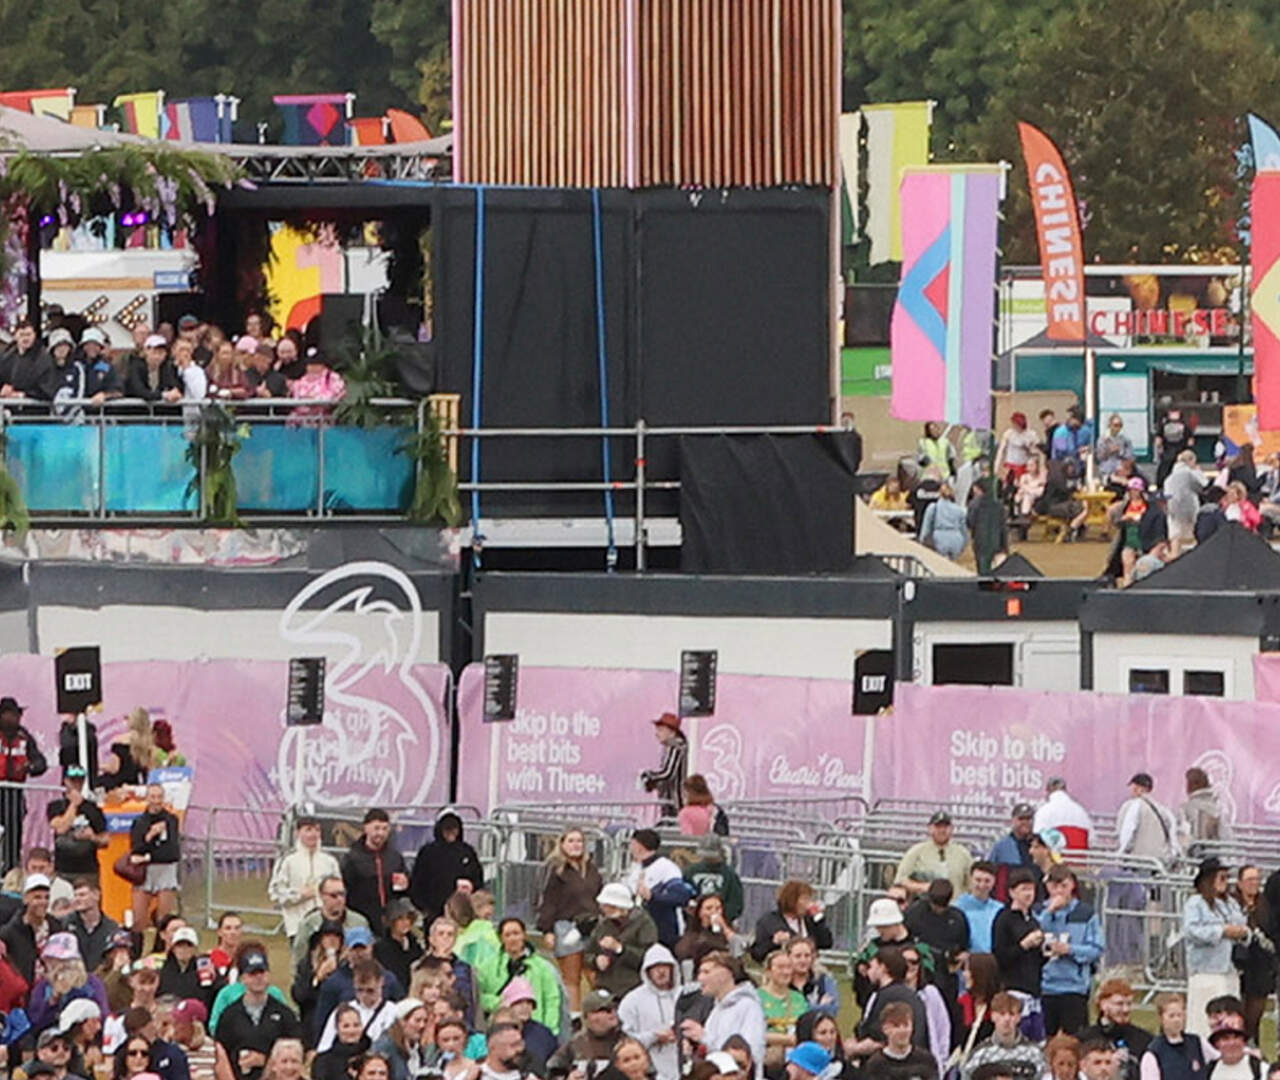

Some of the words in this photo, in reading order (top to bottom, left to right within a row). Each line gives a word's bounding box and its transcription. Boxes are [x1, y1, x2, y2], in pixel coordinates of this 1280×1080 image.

[1091, 309, 1229, 337] CHINESE
[65, 673, 92, 691] EXIT
[862, 674, 887, 693] EXIT
[509, 709, 547, 738] Skip
[550, 712, 570, 735] to
[573, 711, 600, 737] the
[507, 738, 545, 763] best
[549, 740, 581, 764] bits
[950, 729, 998, 763] Skip
[1003, 734, 1025, 760] to
[1032, 733, 1065, 763] the
[506, 766, 543, 791] with
[547, 767, 606, 793] Three+
[823, 757, 865, 789] Picni
[949, 758, 997, 787] best
[1001, 762, 1043, 790] bits
